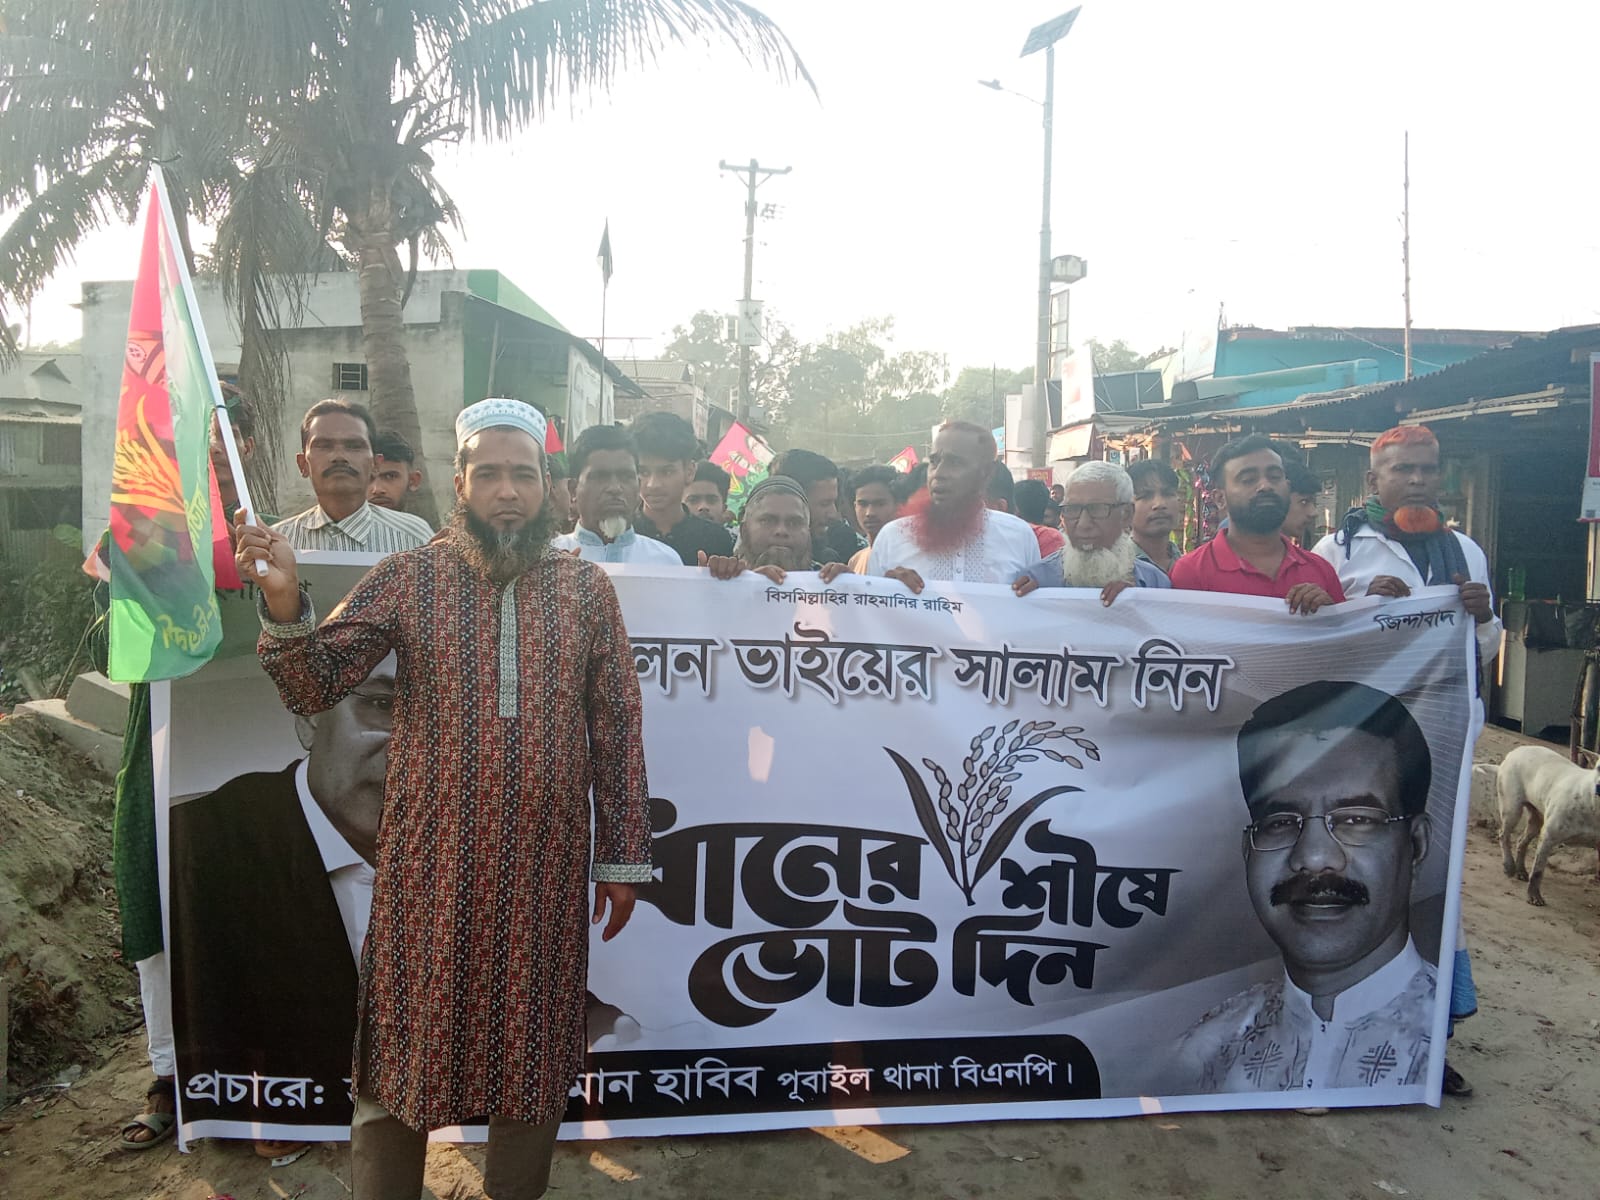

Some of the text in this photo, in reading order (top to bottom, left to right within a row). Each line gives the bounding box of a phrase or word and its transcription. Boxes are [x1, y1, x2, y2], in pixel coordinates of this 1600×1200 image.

[765, 586, 964, 614] বিসমিল্লাহির রাহমানির রাহিম
[1373, 608, 1457, 632] জিন্দাবাদ
[628, 620, 1234, 709] লন ভাইয়ের সালাম নিন
[687, 900, 1111, 1028] ভোট দিন
[568, 1067, 642, 1105] মান
[649, 1056, 766, 1105] হাবিব
[776, 1062, 875, 1103] পূবাইল
[882, 1061, 944, 1091] থানা
